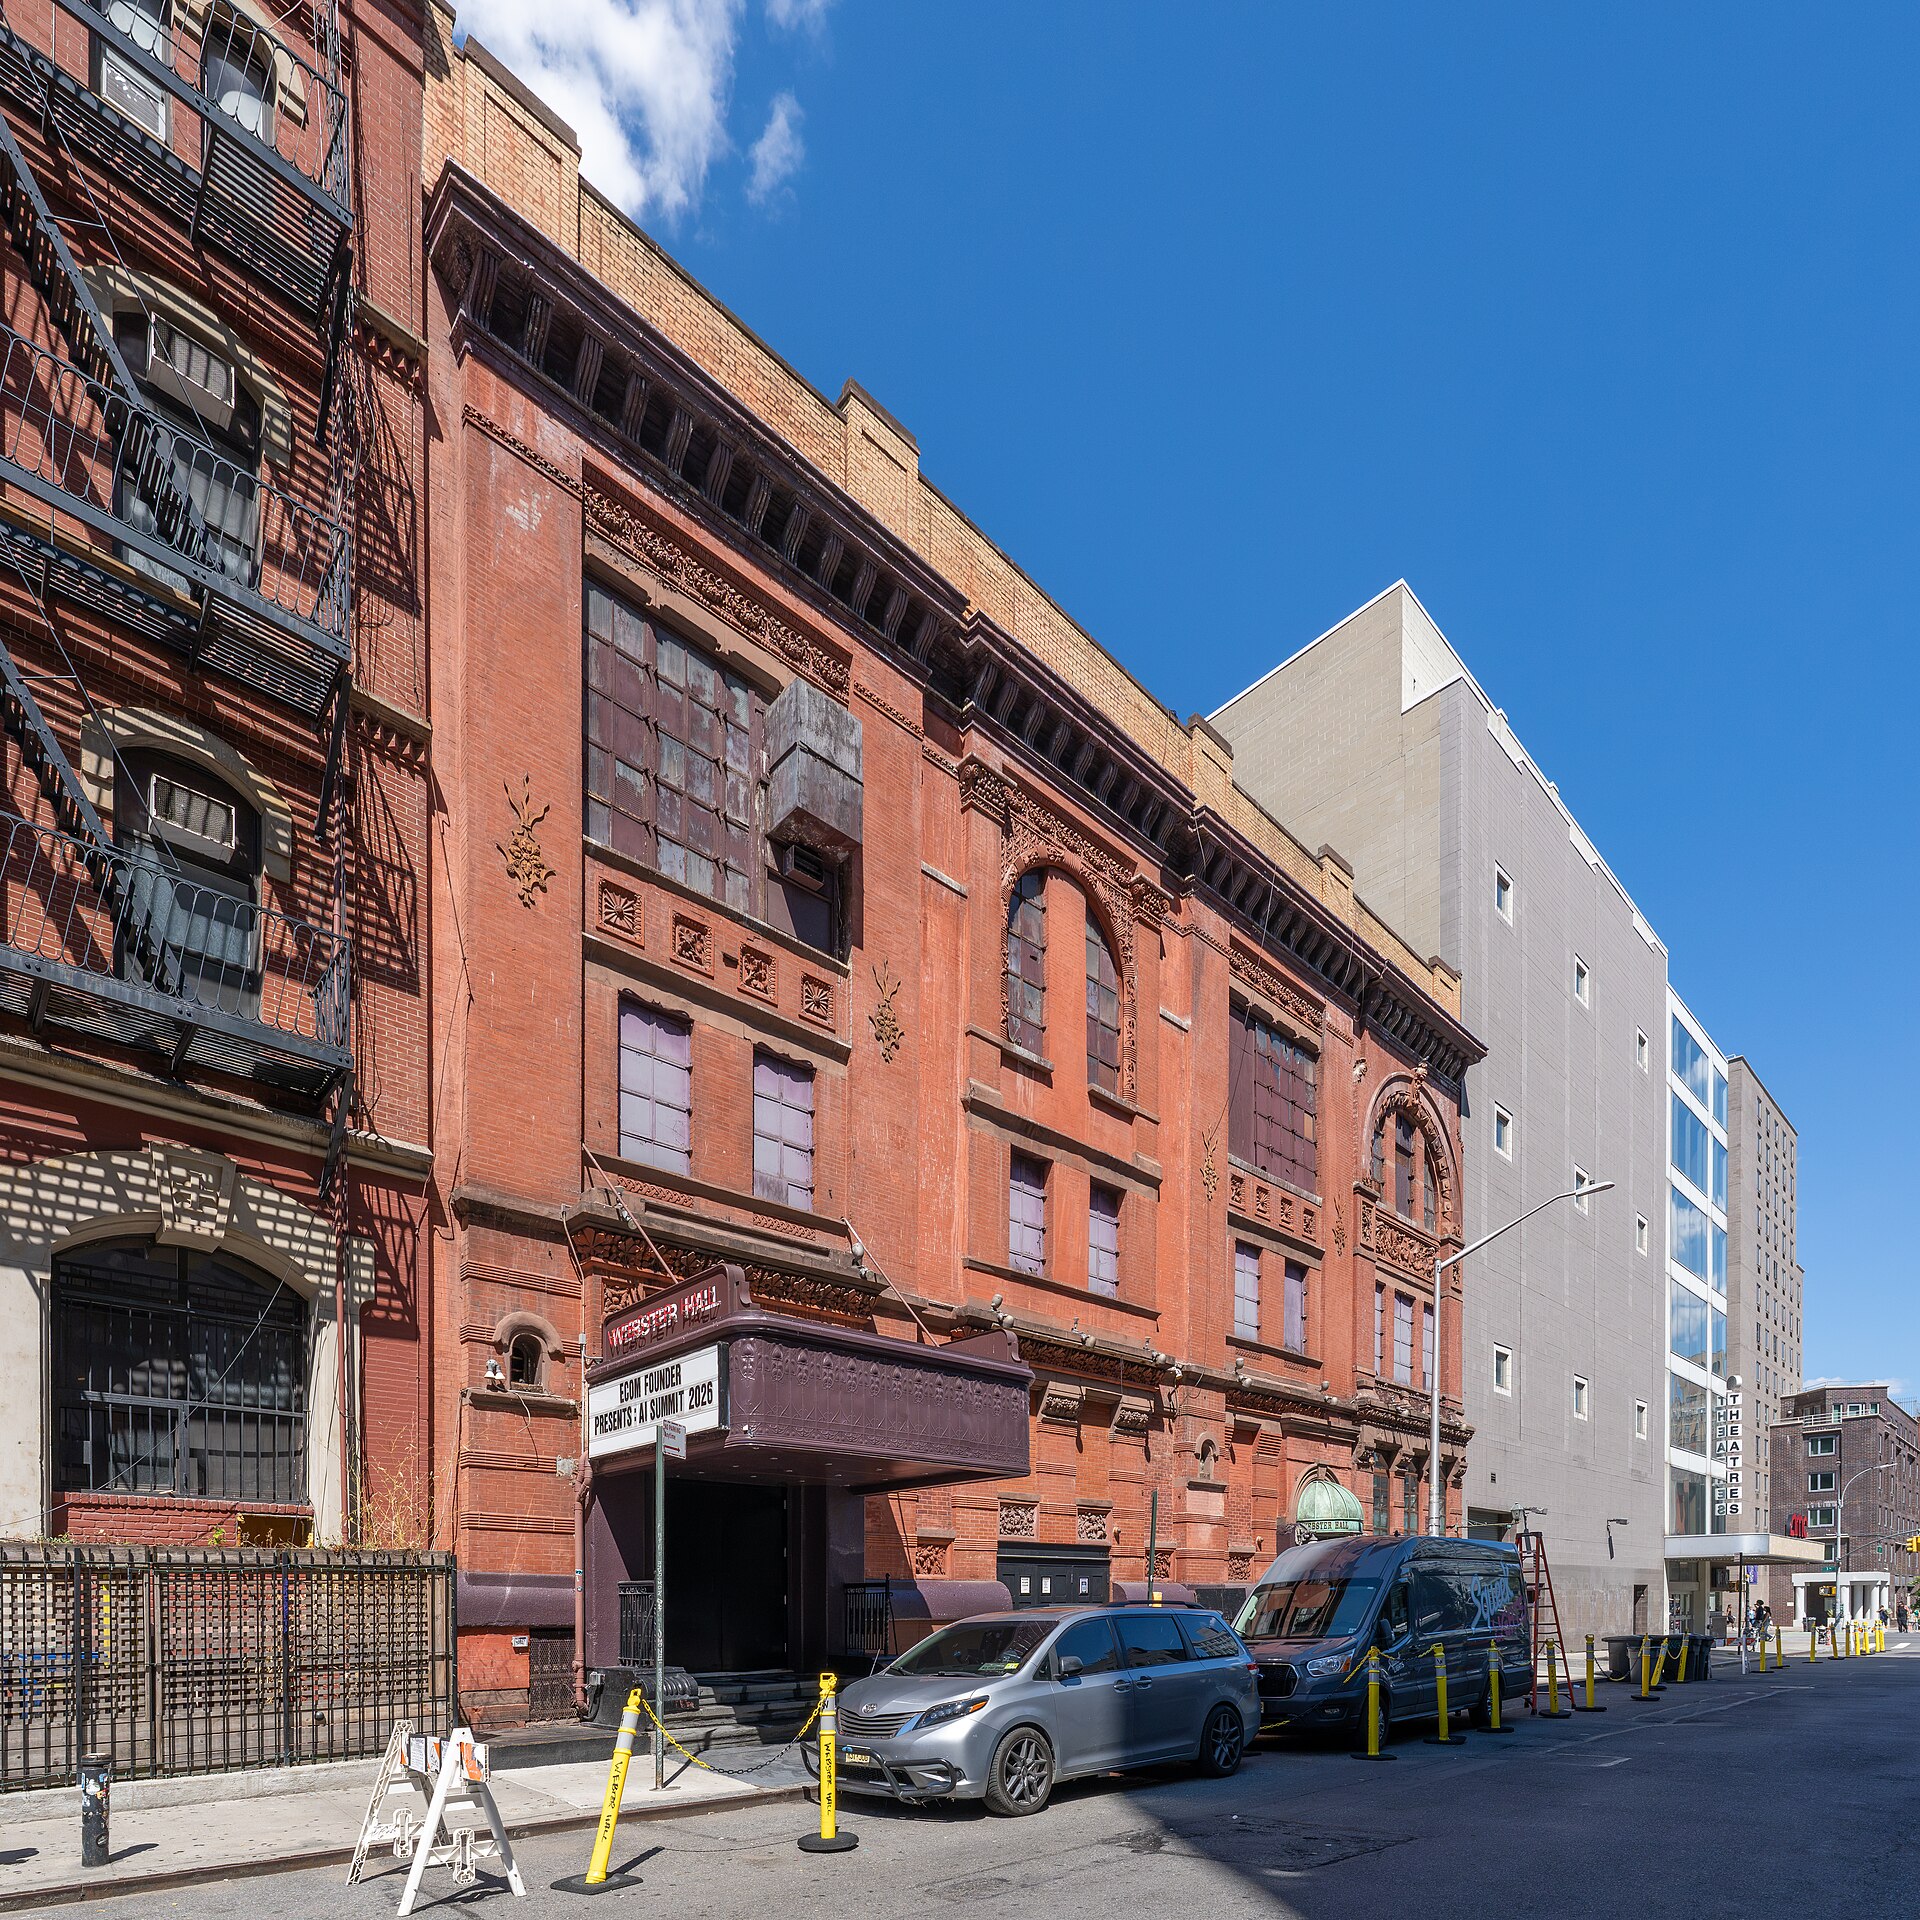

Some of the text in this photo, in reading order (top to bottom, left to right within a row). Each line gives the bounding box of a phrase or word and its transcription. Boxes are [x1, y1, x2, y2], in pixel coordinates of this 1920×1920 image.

[607, 1286, 721, 1347] WEBSTER HALL
[620, 1364, 682, 1403] ECOM FOUNDER
[639, 1403, 647, 1423] AI
[650, 1390, 684, 1420] SUMMIT
[688, 1381, 713, 1410] 2026
[1729, 1394, 1739, 1514] THEATRES
[1306, 1521, 1349, 1529] EBSTER HALL
